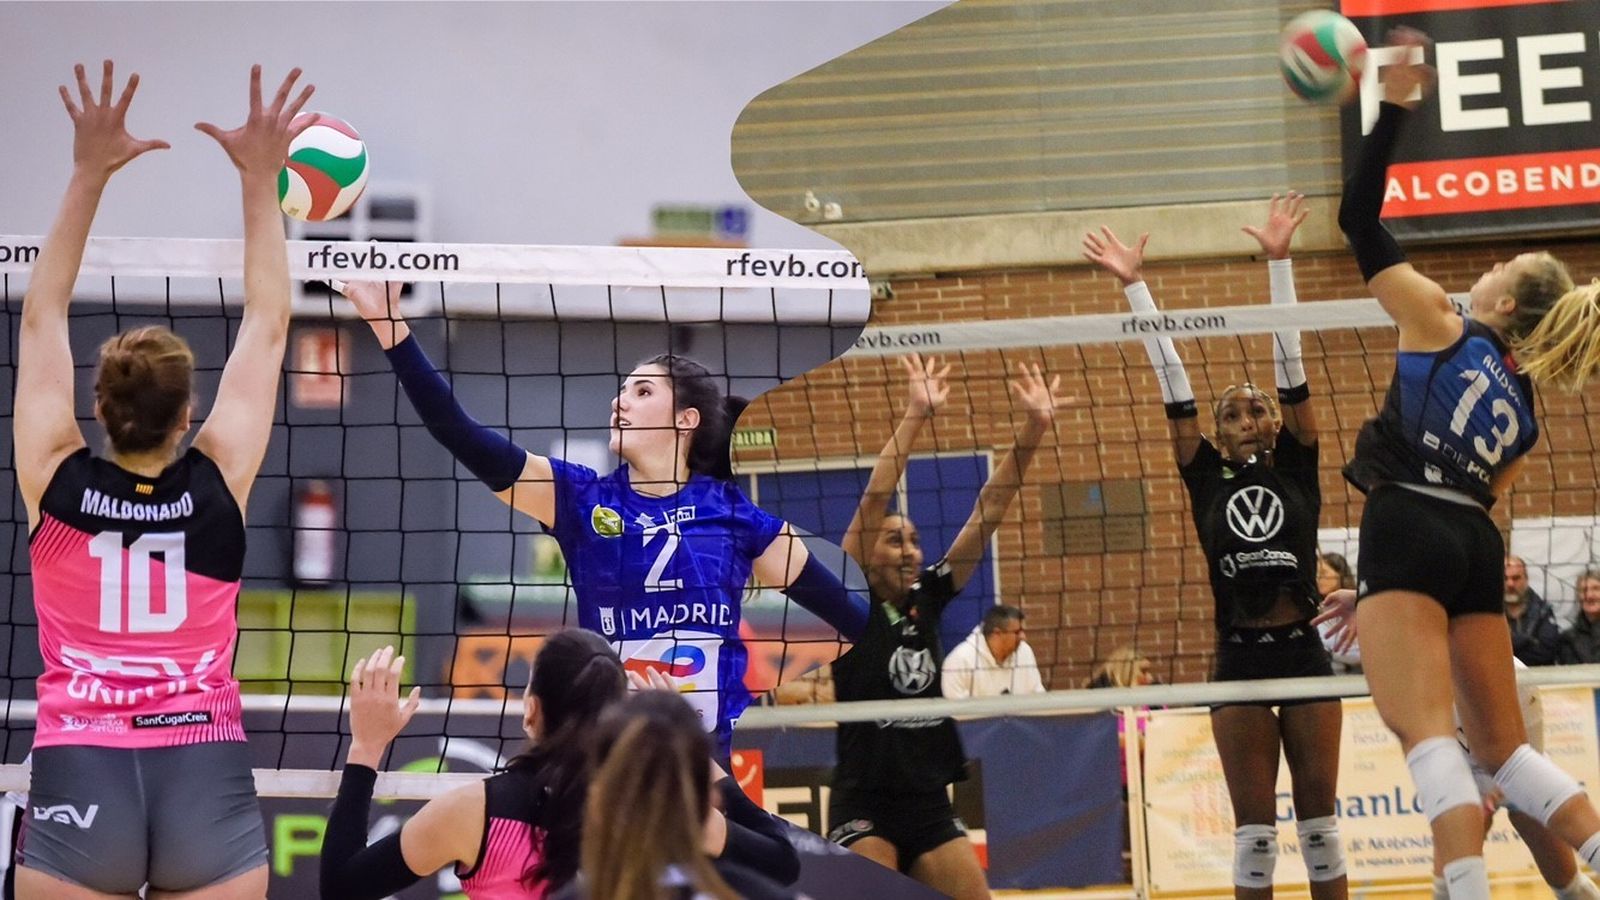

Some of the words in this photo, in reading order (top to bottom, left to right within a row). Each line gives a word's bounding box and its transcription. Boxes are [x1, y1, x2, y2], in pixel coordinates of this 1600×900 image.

[307, 245, 459, 271] rfevb.com
[1121, 314, 1226, 334] rfevb.com
[1457, 369, 1520, 466] 13
[80, 487, 194, 522] MALDONADO
[642, 523, 684, 593] 2
[88, 531, 188, 633] 10
[136, 712, 209, 728] SantCugatCreix
